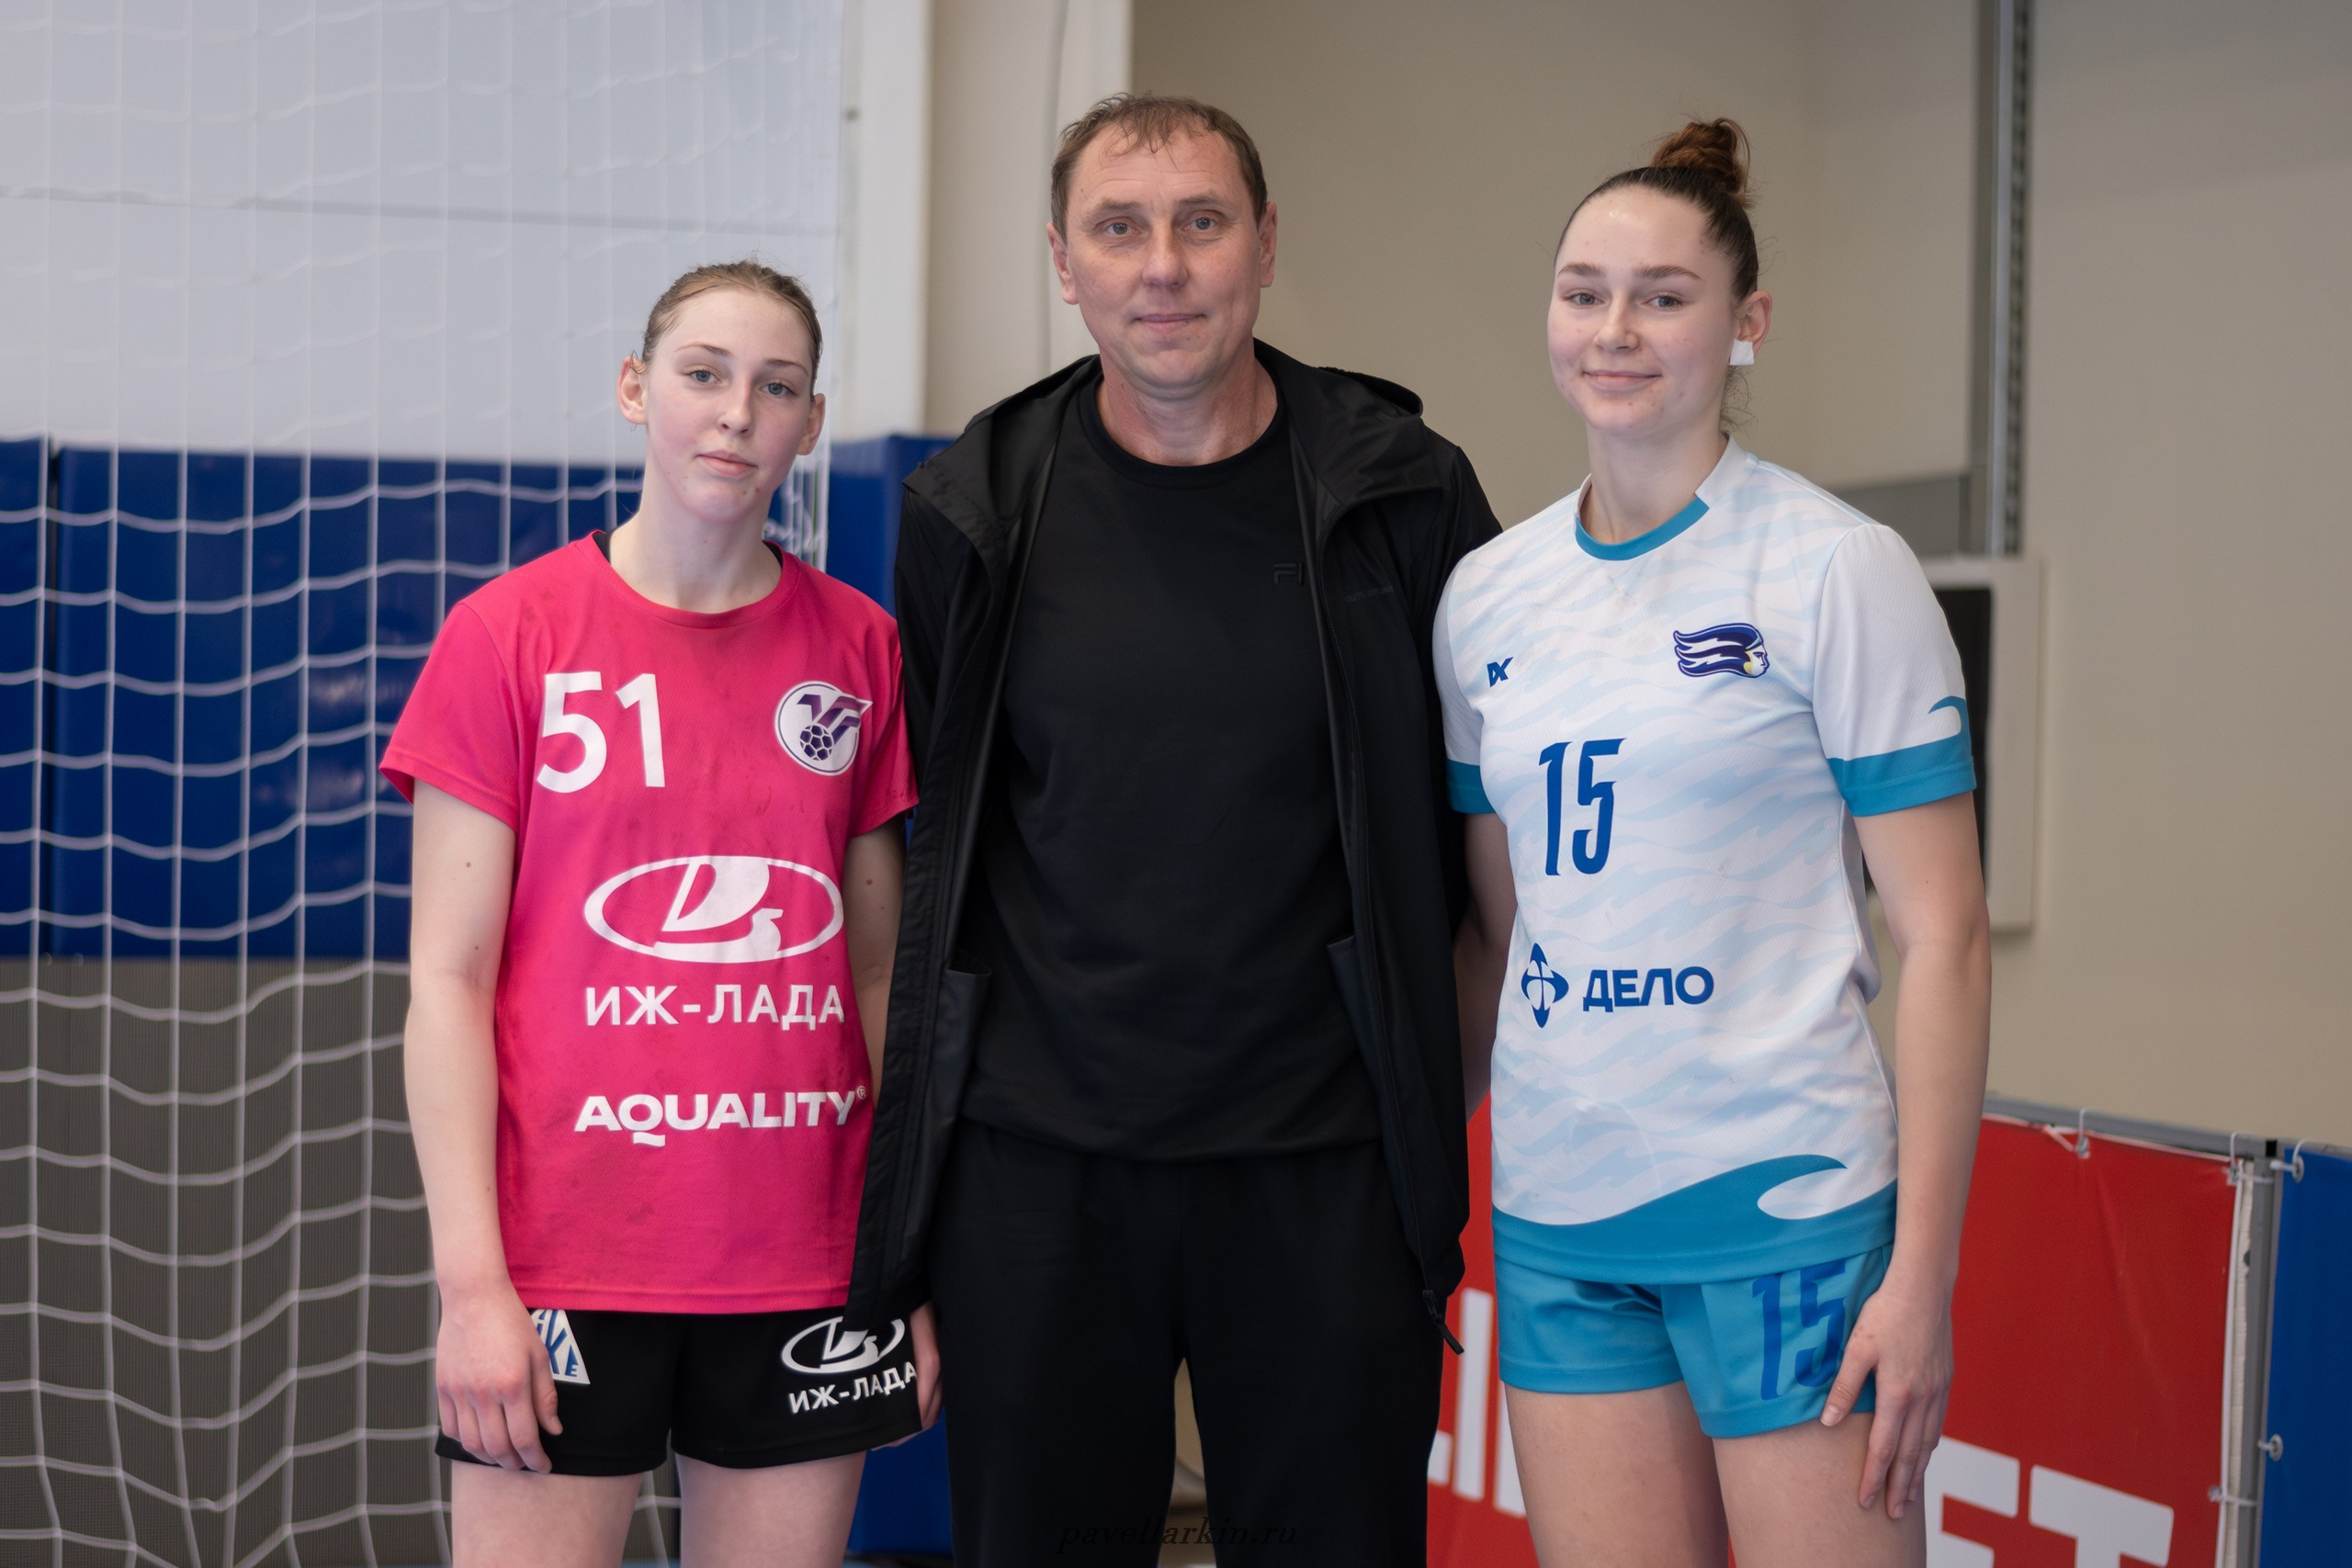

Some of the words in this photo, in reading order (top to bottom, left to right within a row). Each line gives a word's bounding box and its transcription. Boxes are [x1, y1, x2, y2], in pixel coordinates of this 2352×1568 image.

[537, 670, 666, 794] 51
[1539, 738, 1626, 876] 15
[585, 983, 846, 1032] ИЖ-ЛАДА
[1582, 966, 1714, 1013] ДЕЛО
[1751, 1258, 1849, 1402] 15
[788, 1361, 918, 1416] ИЖ-ЛАДА
